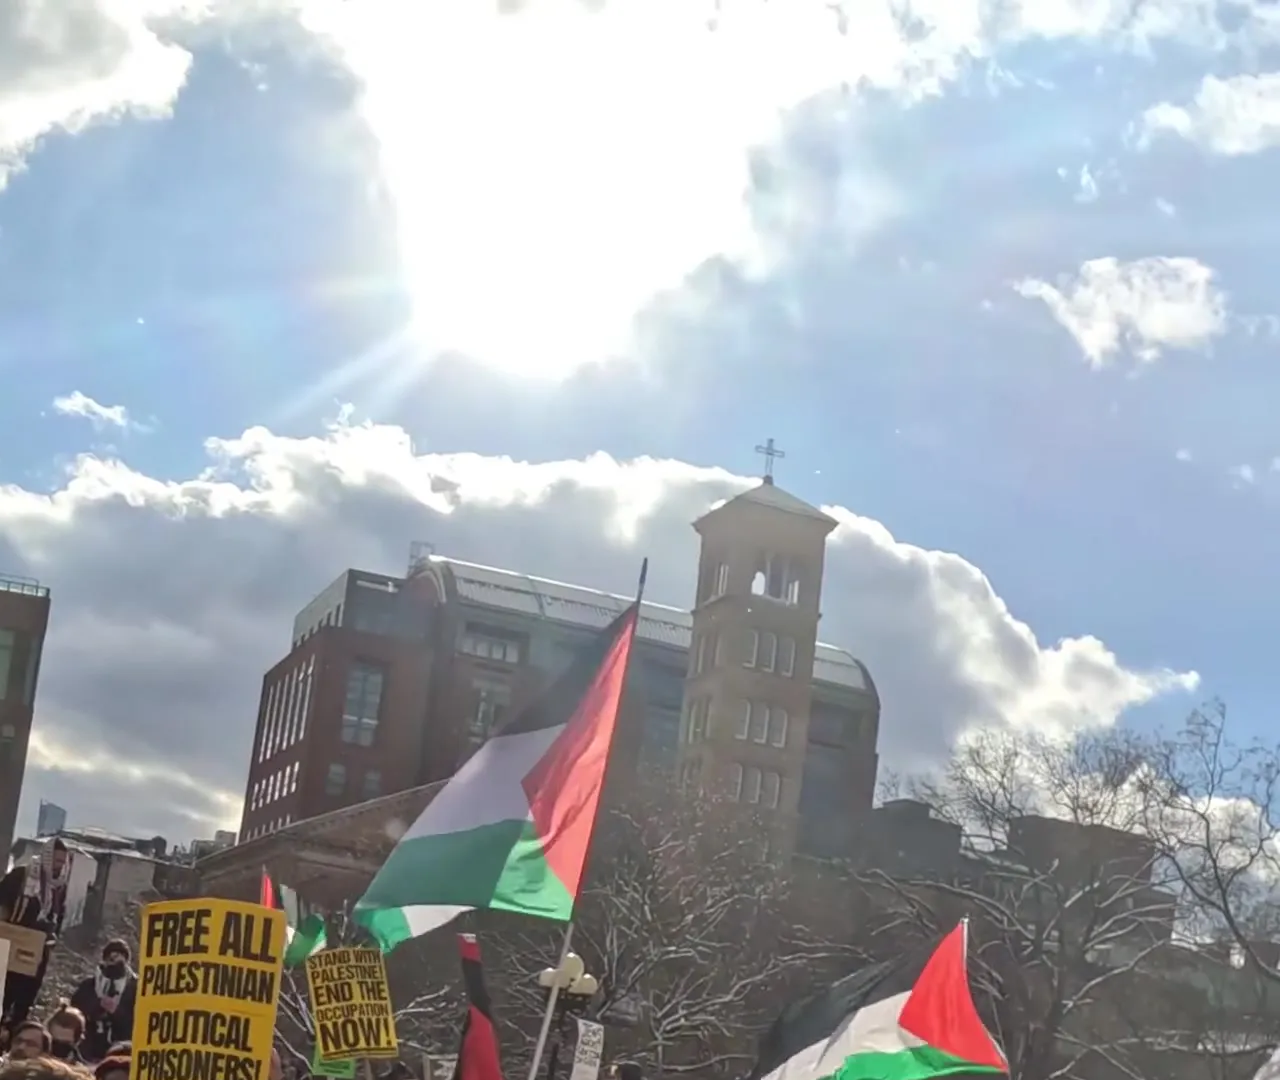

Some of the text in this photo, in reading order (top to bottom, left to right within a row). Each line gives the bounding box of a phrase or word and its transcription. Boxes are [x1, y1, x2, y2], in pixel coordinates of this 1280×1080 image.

[146, 909, 277, 964] FREE ALL
[308, 949, 381, 970] STAND WITH
[311, 965, 384, 985] PALESTINE!
[141, 961, 275, 1005] PALESTINIAN
[314, 980, 388, 1007] END THE
[316, 1003, 389, 1022] OCCUPATION
[147, 1010, 253, 1053] POLITICAL
[320, 1017, 392, 1052] NOW!
